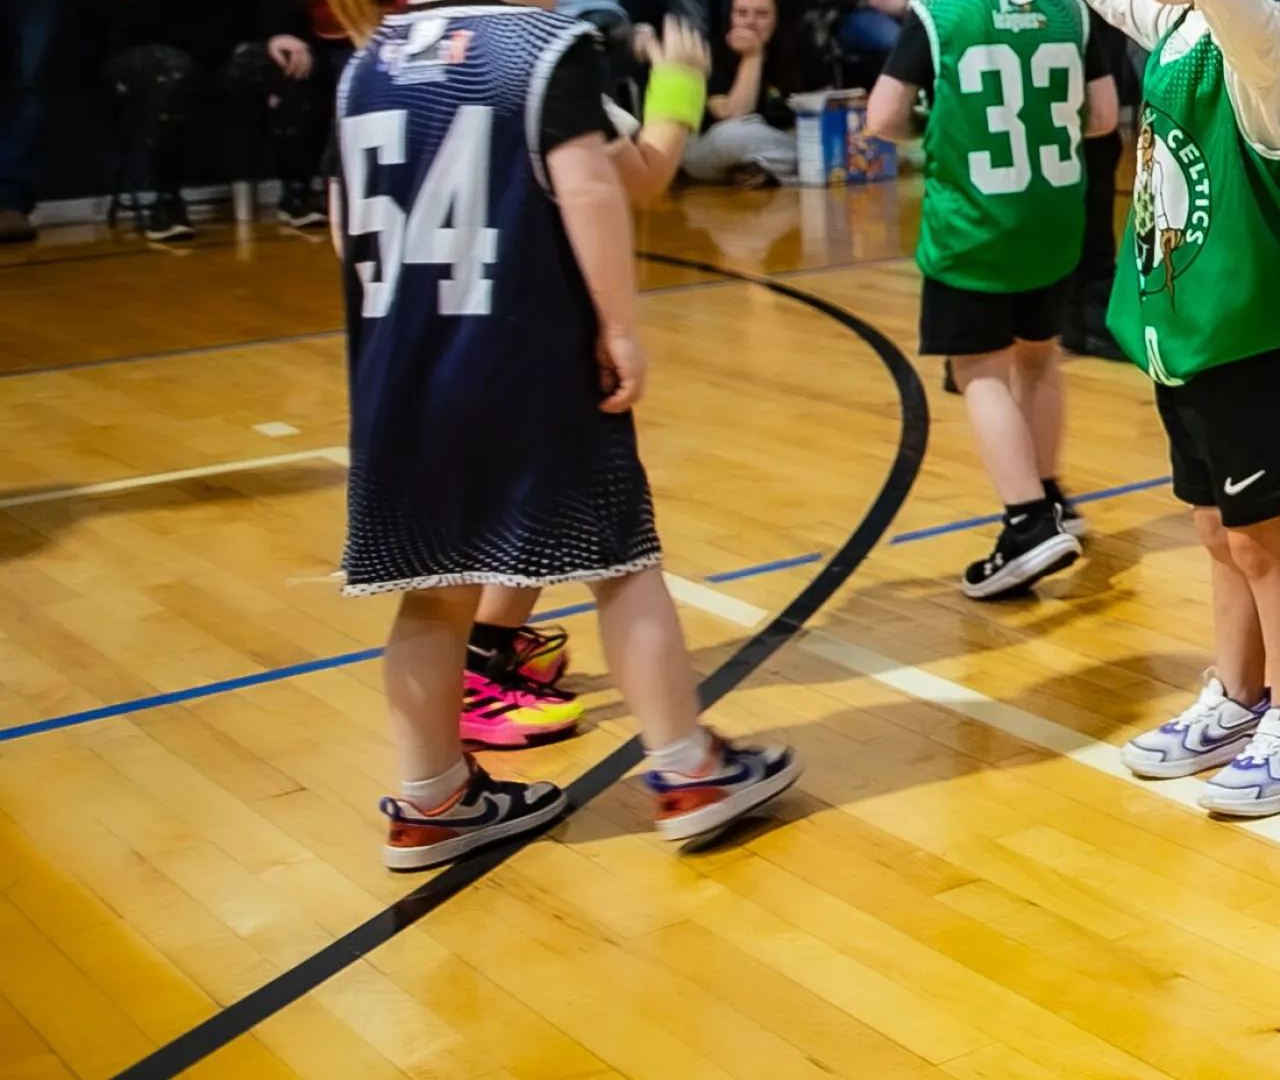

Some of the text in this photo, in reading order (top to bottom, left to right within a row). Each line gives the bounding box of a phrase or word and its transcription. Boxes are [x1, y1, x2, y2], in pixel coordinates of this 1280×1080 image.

[957, 41, 1085, 196] 33
[1167, 128, 1211, 246] CELTICS
[340, 104, 499, 318] 54
